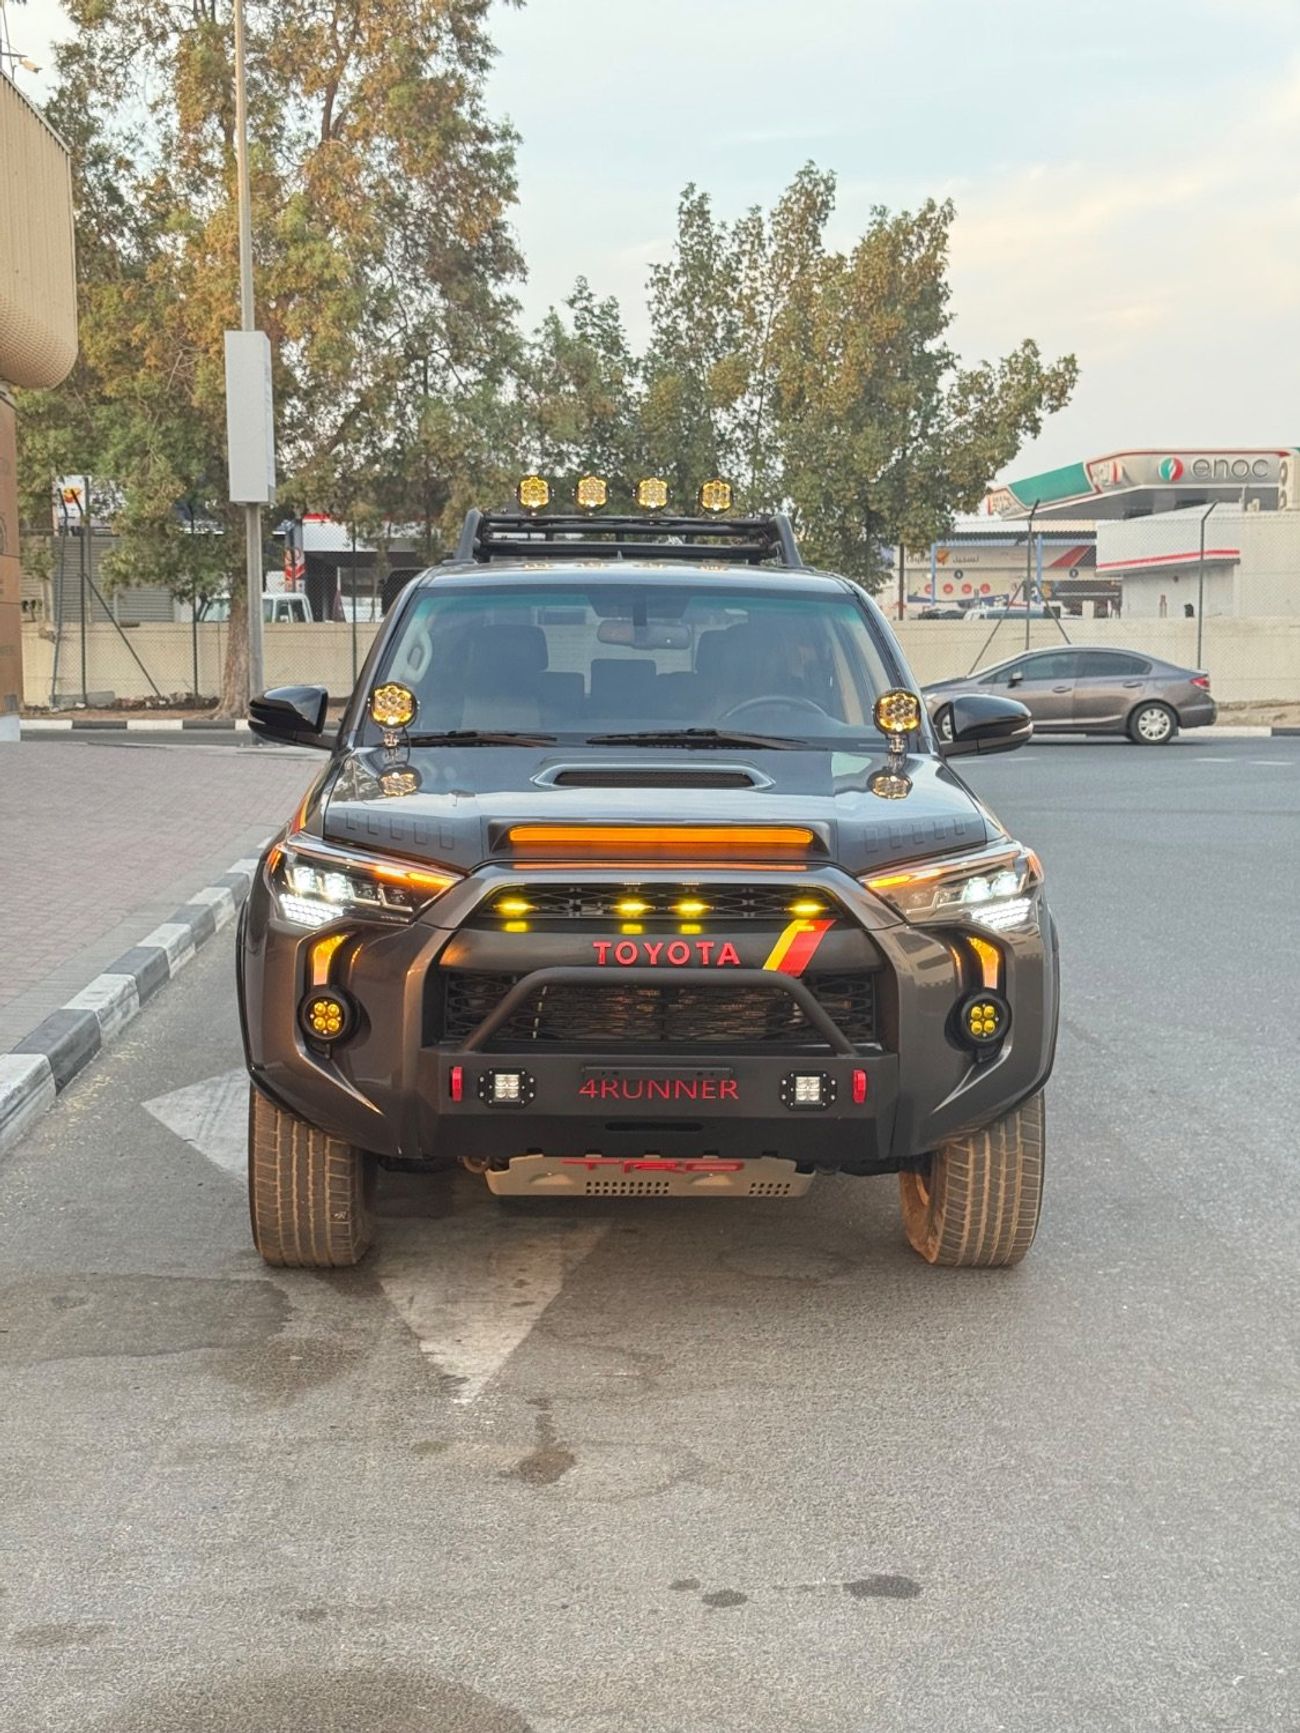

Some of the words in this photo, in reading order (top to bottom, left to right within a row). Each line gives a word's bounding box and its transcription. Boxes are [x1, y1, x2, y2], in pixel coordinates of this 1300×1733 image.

[1192, 458, 1269, 479] enoc
[592, 940, 741, 966] TOYOTA
[579, 1079, 739, 1100] 4RUNNER
